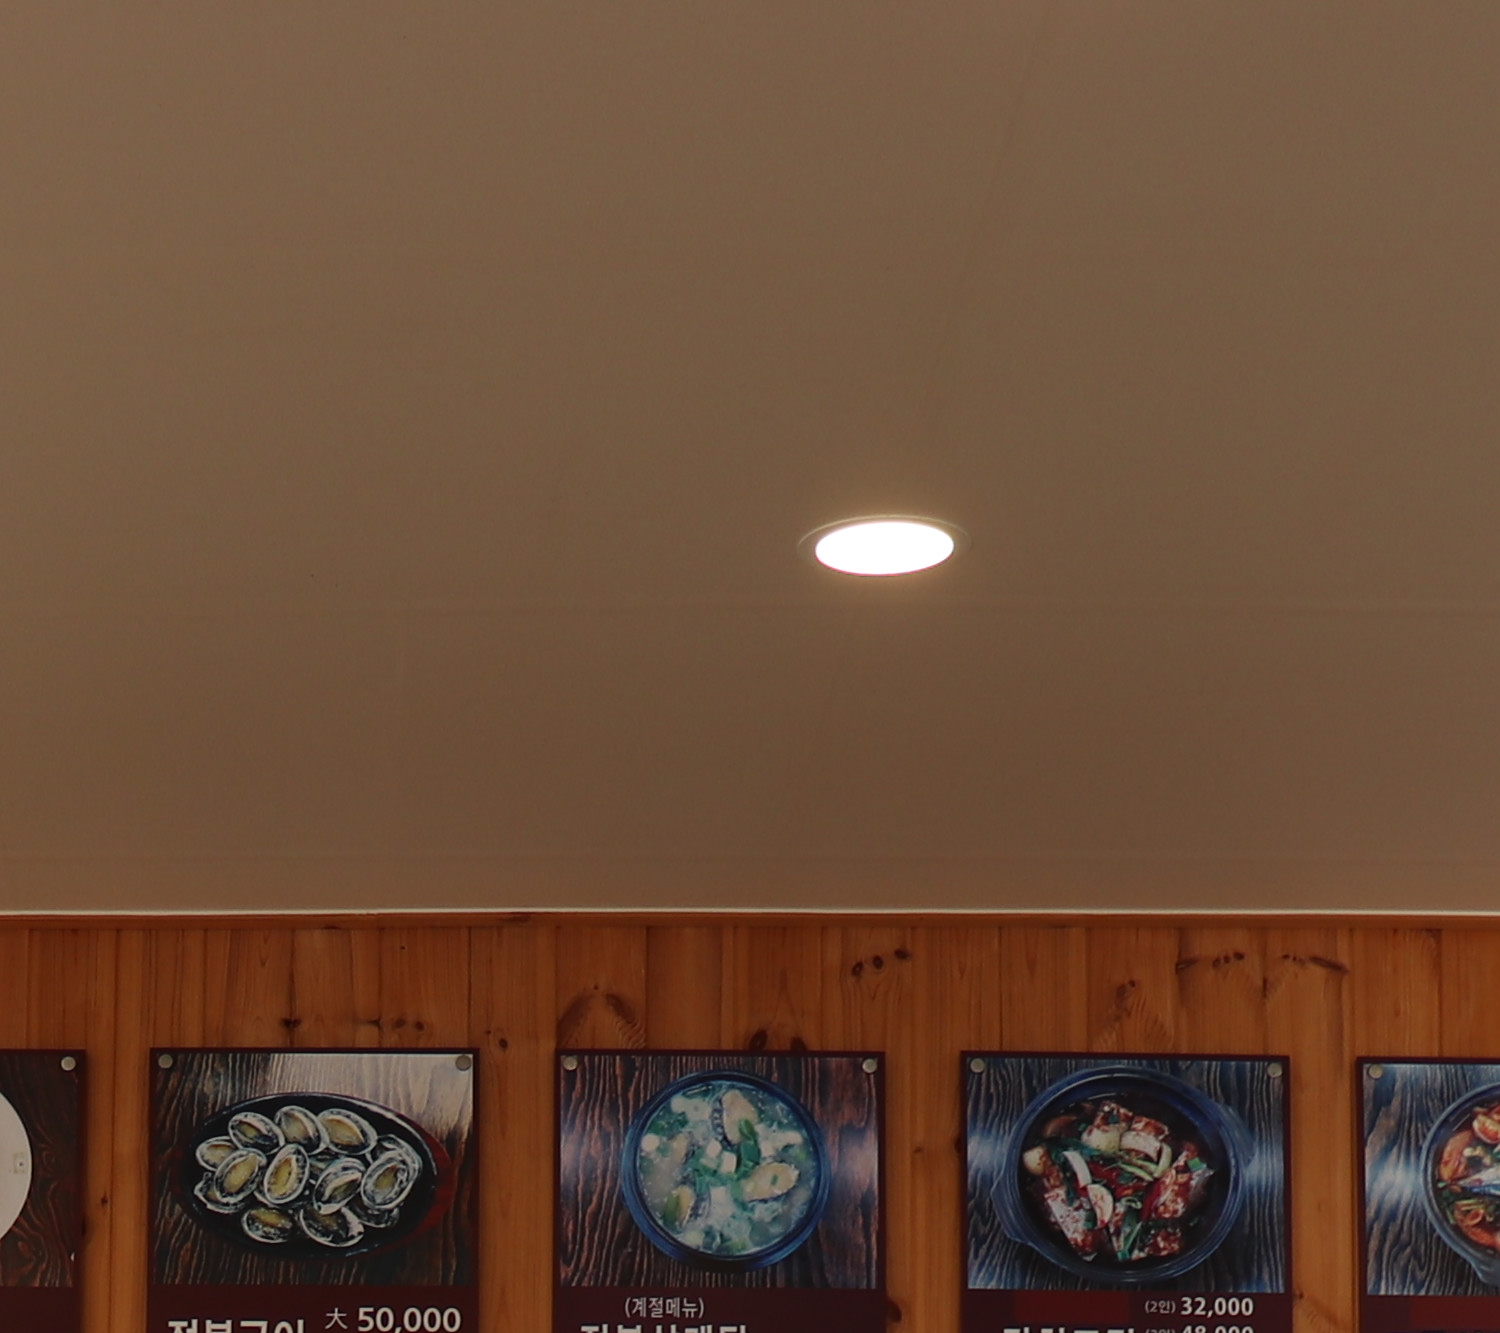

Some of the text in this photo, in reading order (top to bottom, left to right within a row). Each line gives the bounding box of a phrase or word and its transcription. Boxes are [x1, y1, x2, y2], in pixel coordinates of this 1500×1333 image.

[624, 1296, 706, 1319] (계절메뉴)
[1144, 1296, 1255, 1319] (2인) 32,000
[324, 1308, 348, 1331] 大
